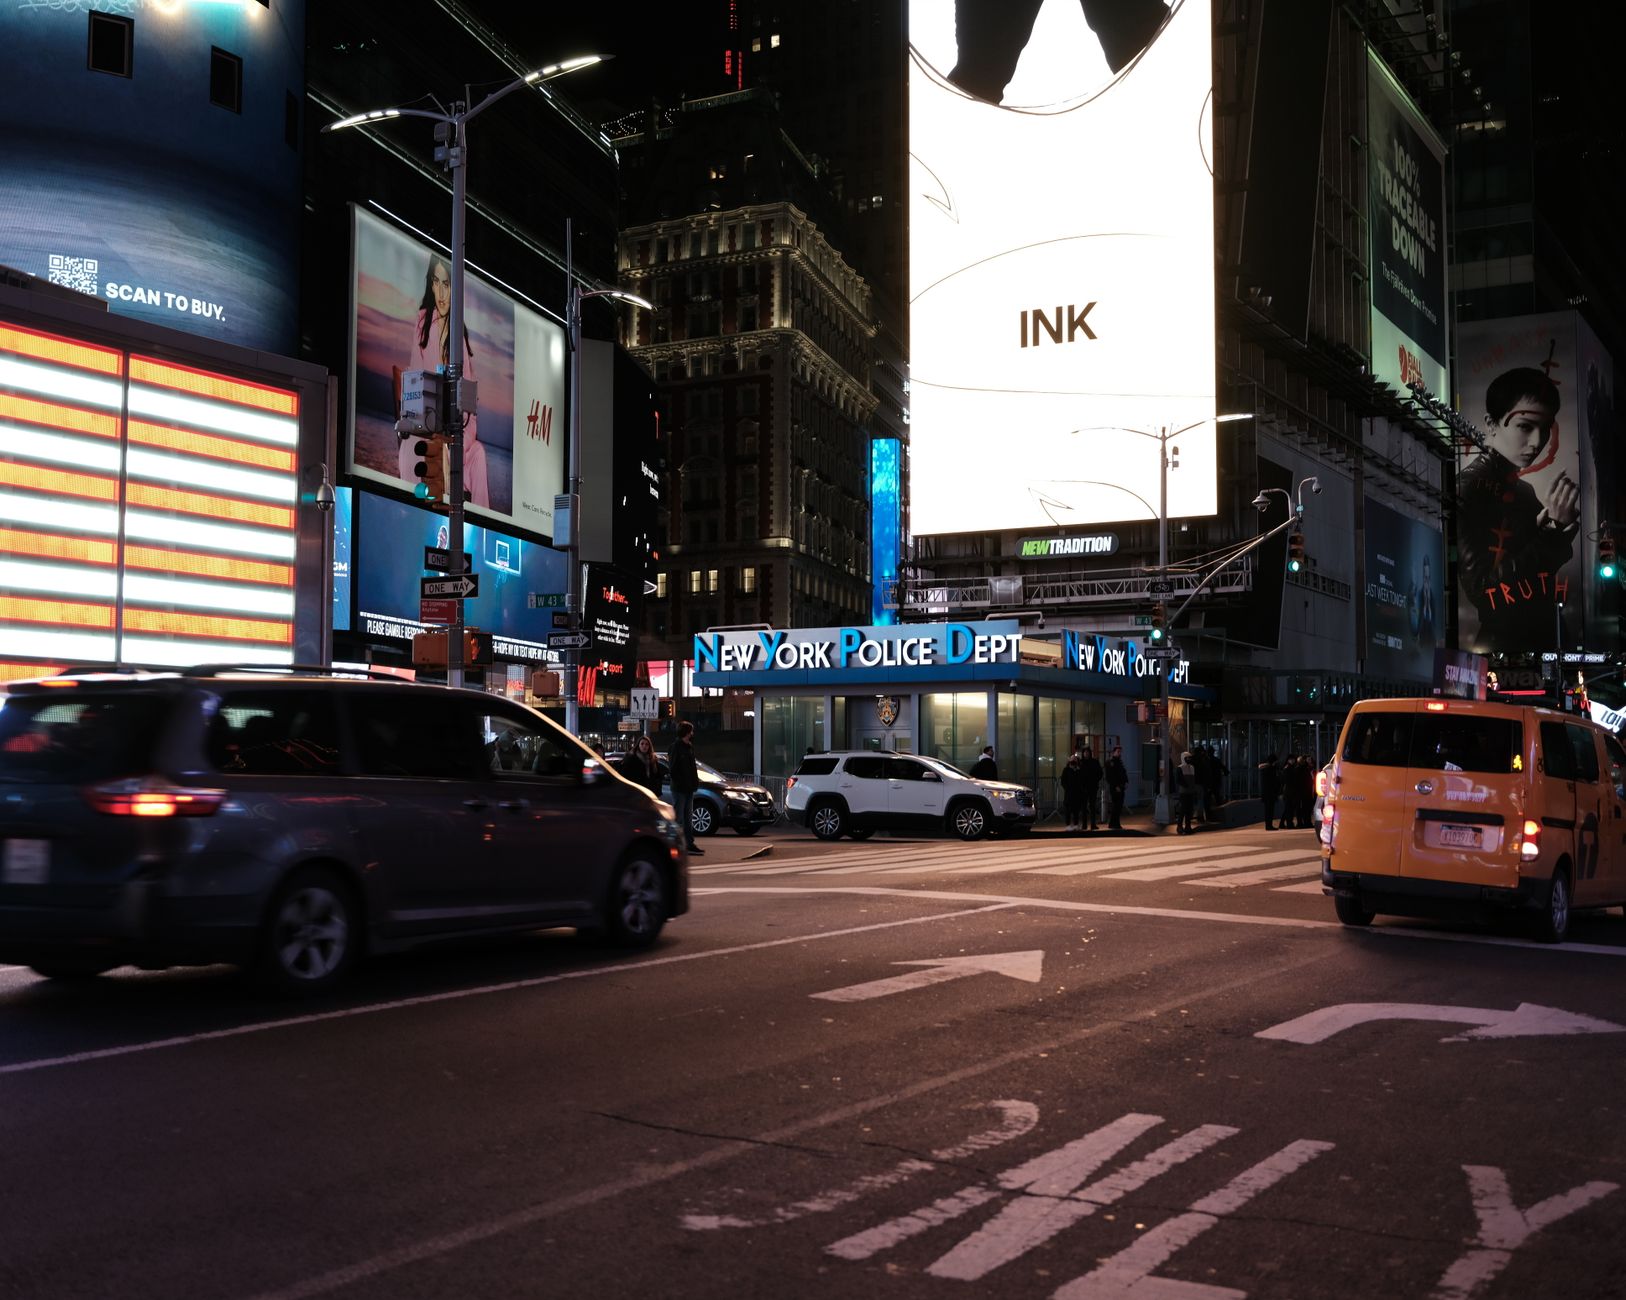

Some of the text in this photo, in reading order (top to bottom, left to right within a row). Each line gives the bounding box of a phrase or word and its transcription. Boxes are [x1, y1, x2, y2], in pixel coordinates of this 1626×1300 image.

[1394, 138, 1421, 198] 100%
[1378, 159, 1436, 253] TRACEABLE
[1391, 215, 1426, 279] DOWN
[106, 282, 226, 322] SCAN TO BUY.
[1020, 301, 1098, 349] INK
[527, 398, 552, 447] H&M
[432, 555, 446, 565] ONE
[429, 581, 470, 593] ONE WAY
[537, 595, 545, 607] W
[547, 595, 557, 607] 43
[1365, 583, 1407, 608] LAST WEEK TONIGHT
[1485, 572, 1568, 610] TRUTH
[367, 620, 385, 636] PLEASE
[385, 623, 405, 639] GAMBLE
[553, 637, 566, 645] ONE
[694, 623, 1023, 673] NEW YORK POLICE DEPT
[1065, 631, 1095, 671] NEW
[1096, 634, 1126, 676] YORK
[1445, 664, 1460, 681] STAY
[1585, 654, 1605, 662] PRIME
